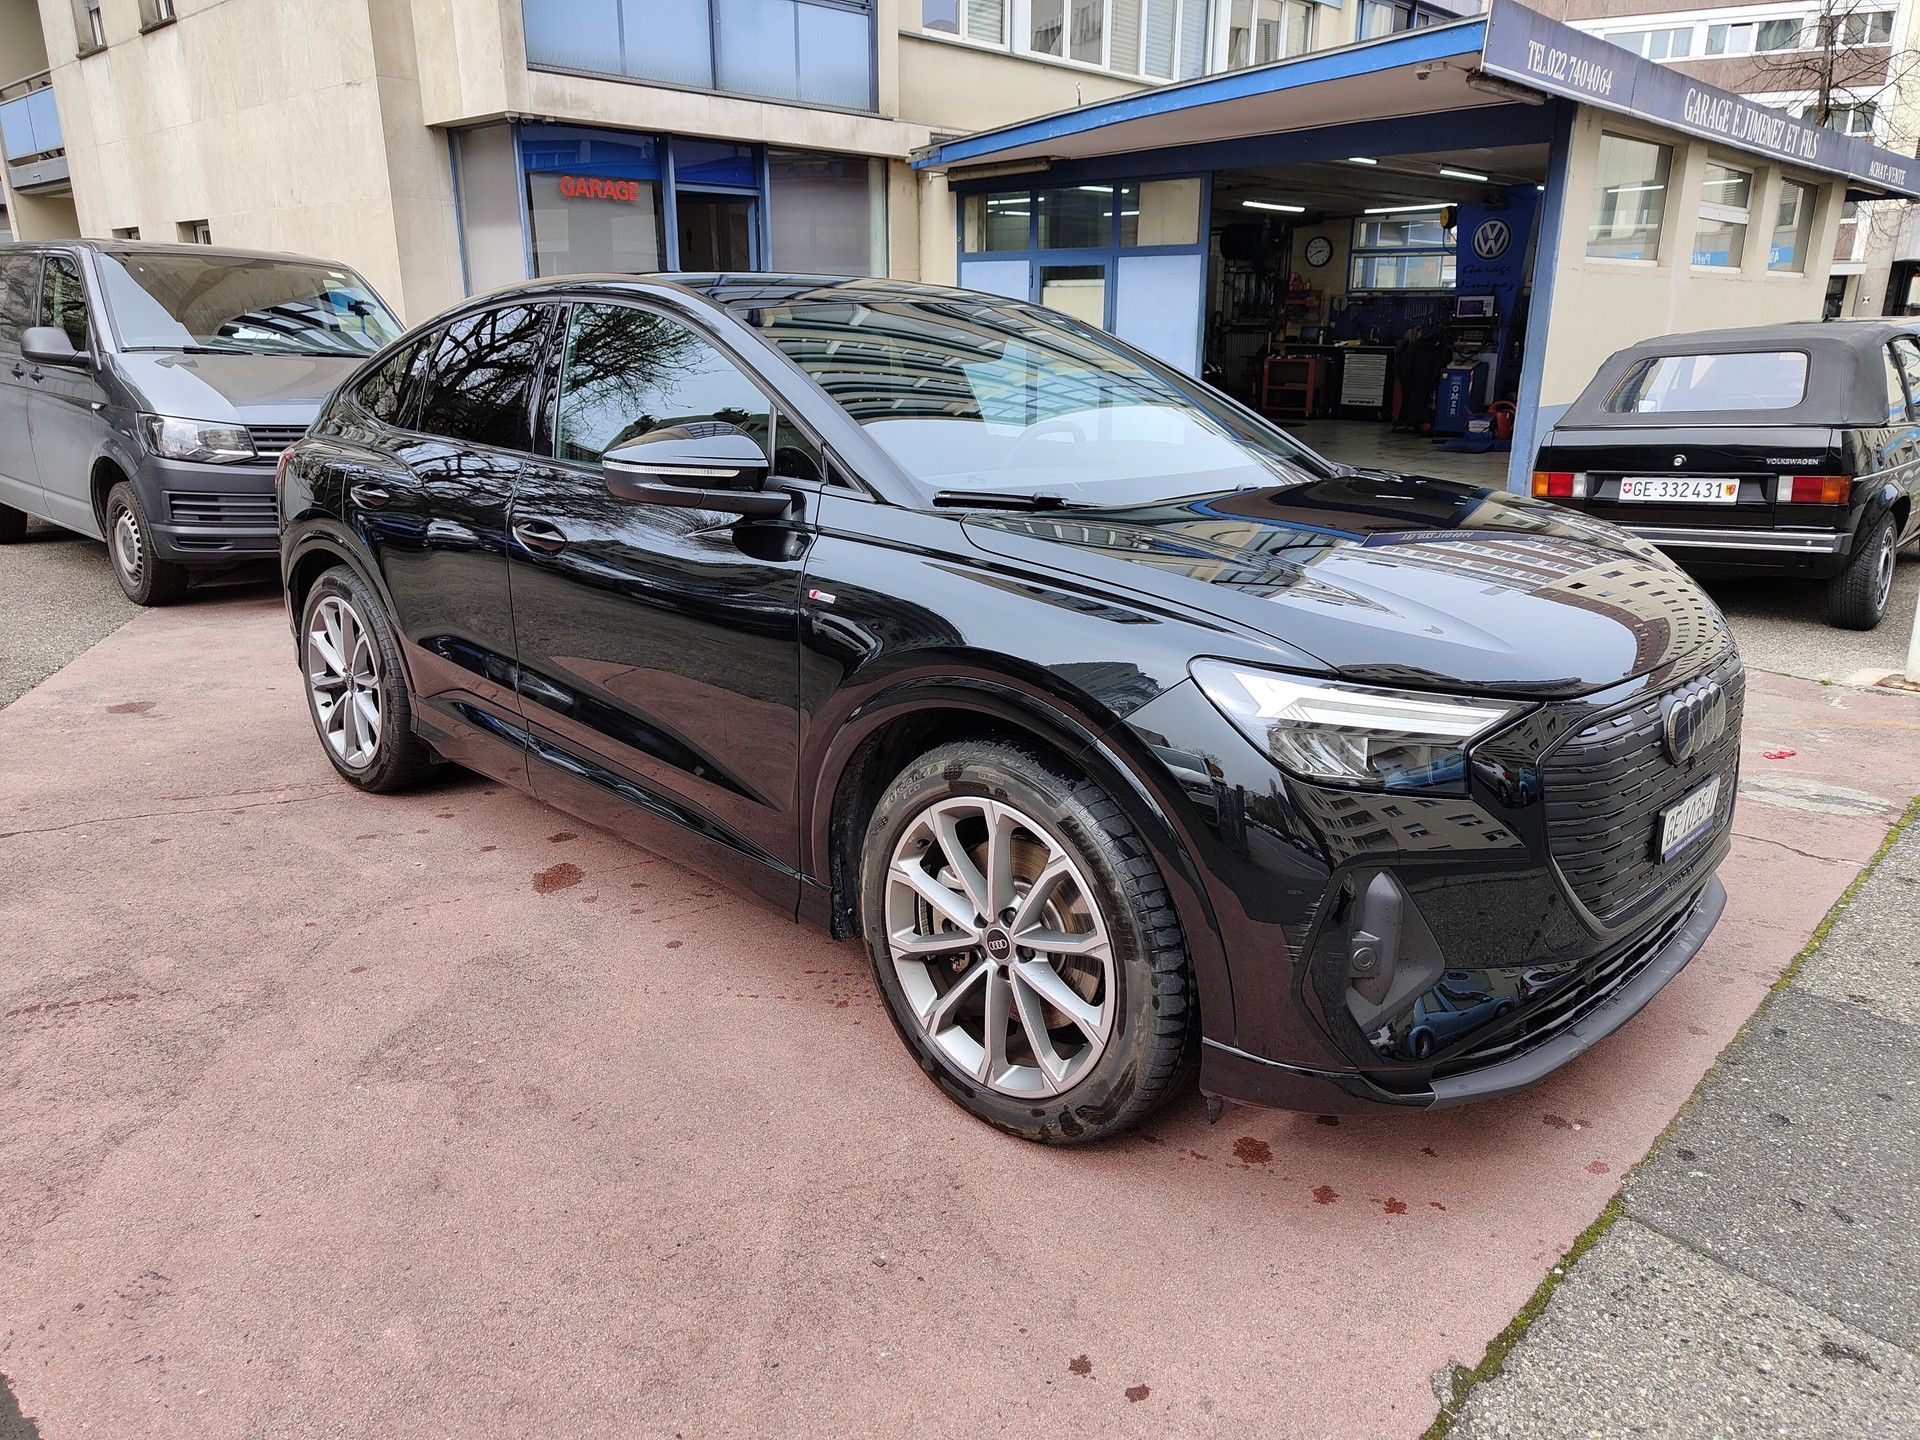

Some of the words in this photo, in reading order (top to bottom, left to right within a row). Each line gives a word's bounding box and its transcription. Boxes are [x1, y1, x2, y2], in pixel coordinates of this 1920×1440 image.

[1527, 40, 1567, 80] TEL.022
[1568, 56, 1613, 95] 7404064
[1684, 87, 1733, 133] GARAGE
[1784, 123, 1801, 153] ET
[1799, 129, 1820, 159] FILS
[1868, 160, 1907, 186] ACHAT-VENTE
[560, 175, 640, 201] GARAGE
[1463, 264, 1513, 276] Garage
[903, 783, 921, 800] ECO
